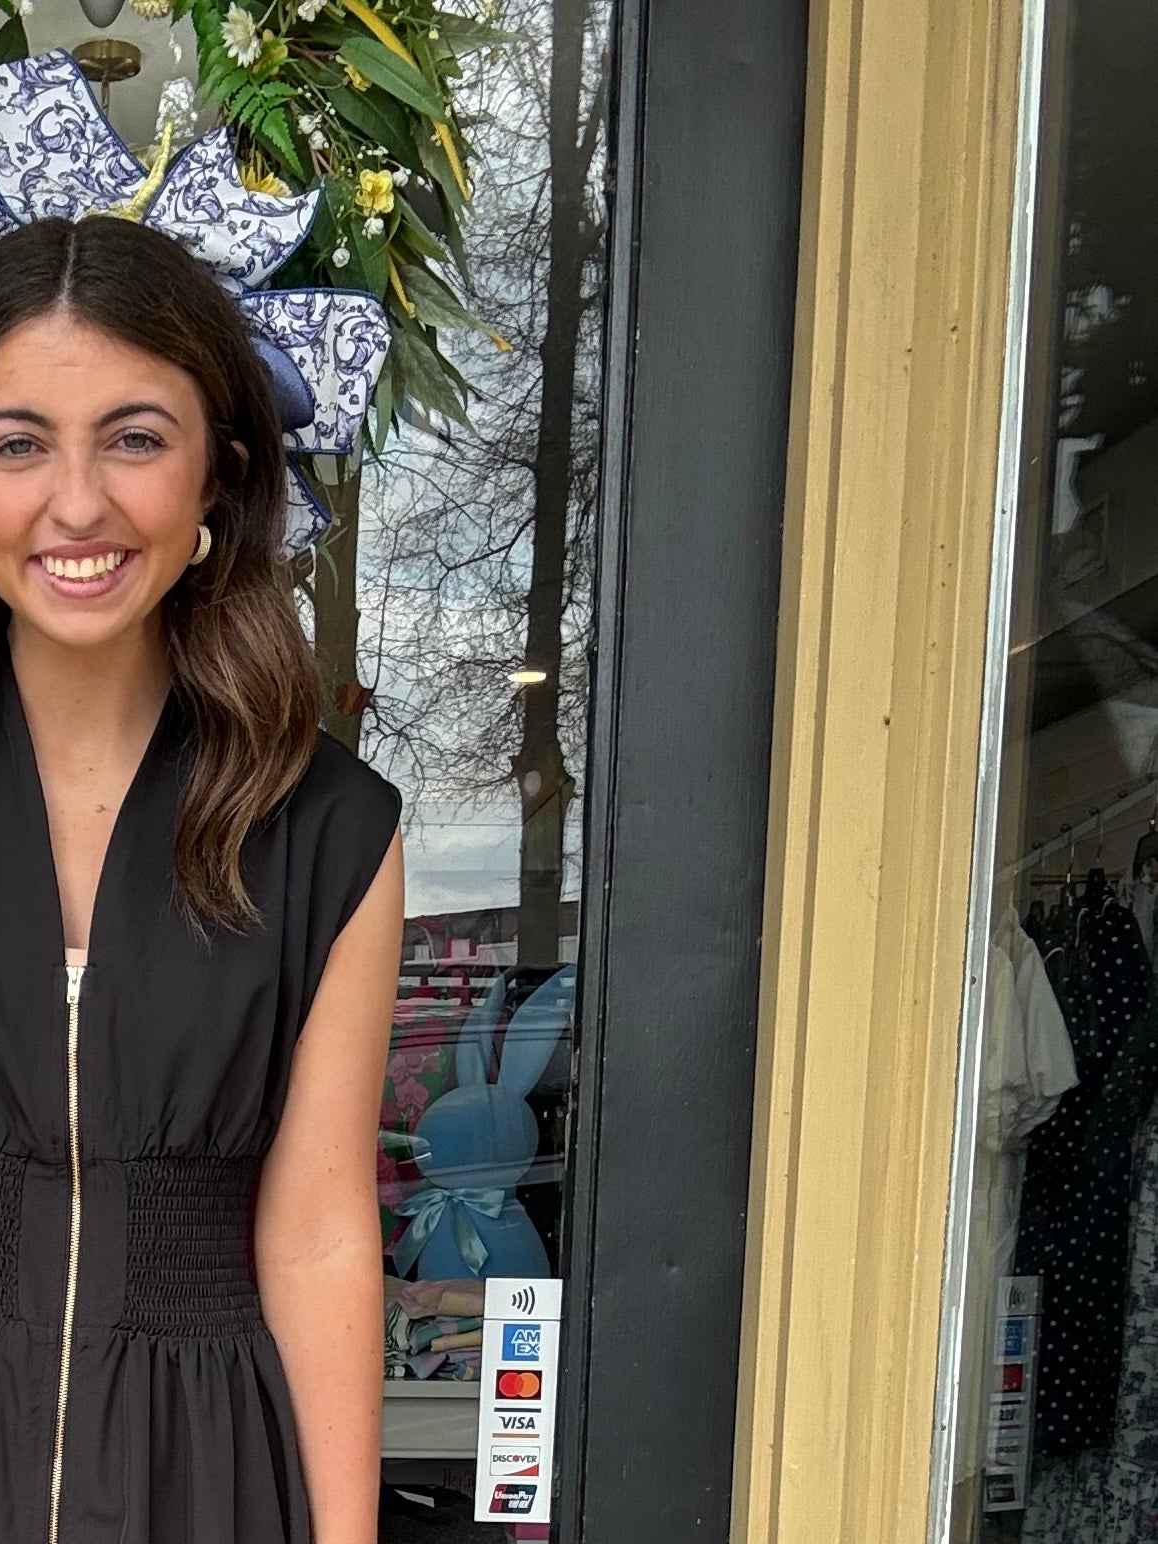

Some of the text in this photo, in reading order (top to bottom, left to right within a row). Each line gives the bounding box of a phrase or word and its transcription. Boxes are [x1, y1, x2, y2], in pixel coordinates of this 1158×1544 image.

[513, 1330, 540, 1343] AM
[498, 1416, 536, 1429] VISA
[492, 1454, 538, 1463] DISCOVER
